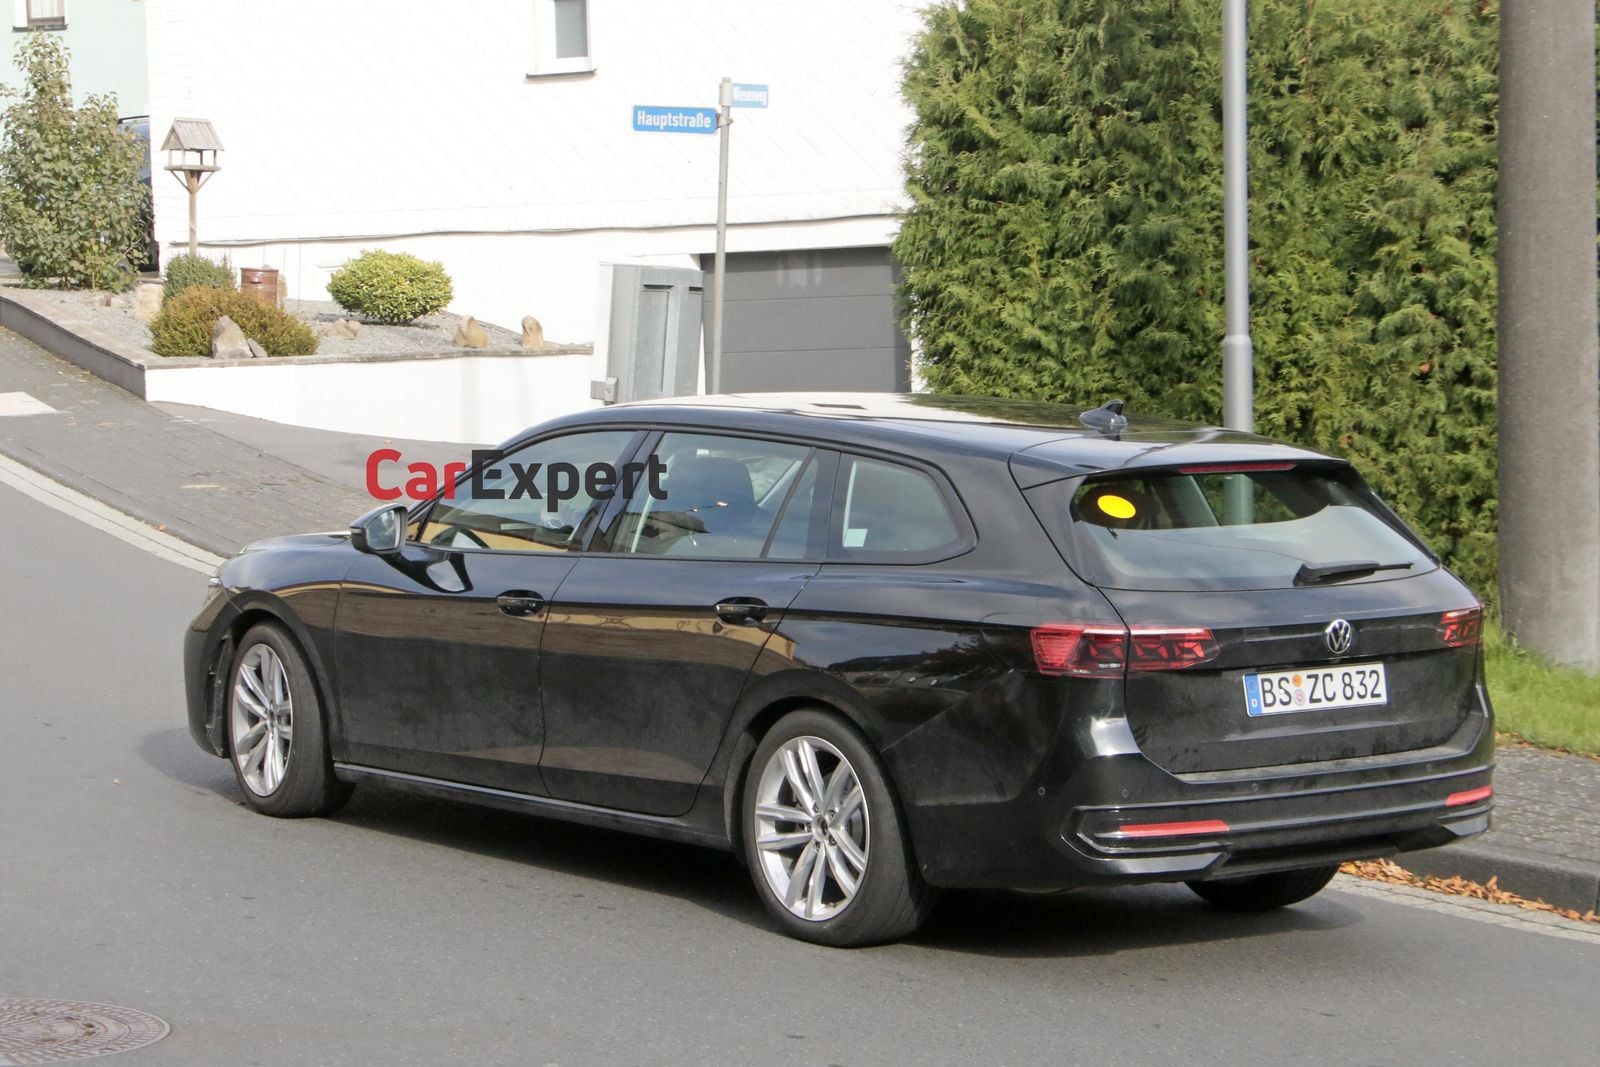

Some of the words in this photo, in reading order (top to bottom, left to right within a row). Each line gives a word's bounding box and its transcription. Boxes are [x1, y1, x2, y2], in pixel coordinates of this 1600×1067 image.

[637, 110, 712, 130] Hauptstraße
[1260, 677, 1292, 708] BS
[1306, 672, 1337, 704] ZC
[1341, 669, 1382, 701] 832
